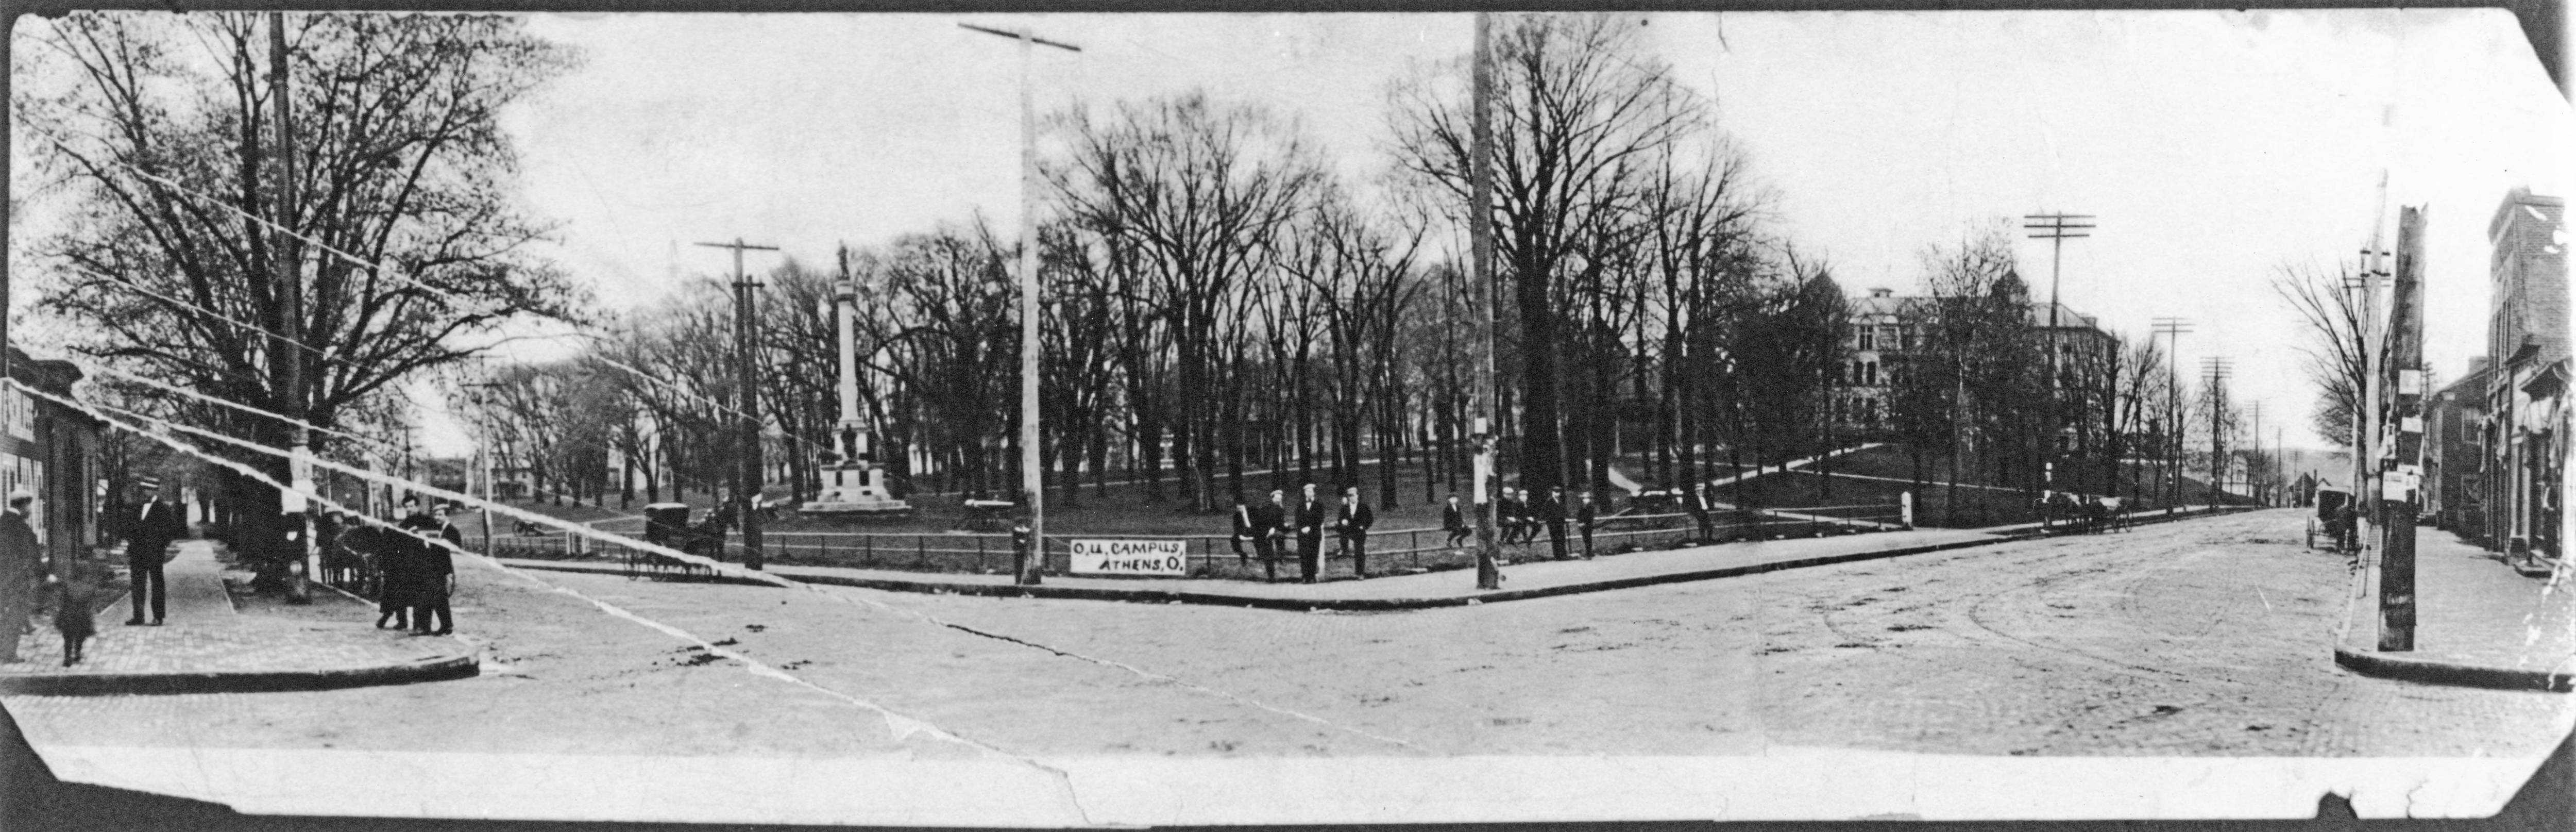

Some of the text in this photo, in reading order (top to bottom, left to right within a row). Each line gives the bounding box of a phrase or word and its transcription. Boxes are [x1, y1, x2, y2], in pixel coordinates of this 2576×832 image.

[1111, 542, 1183, 557] CAMPUS,
[1099, 556, 1183, 572] ATHENS, O.
